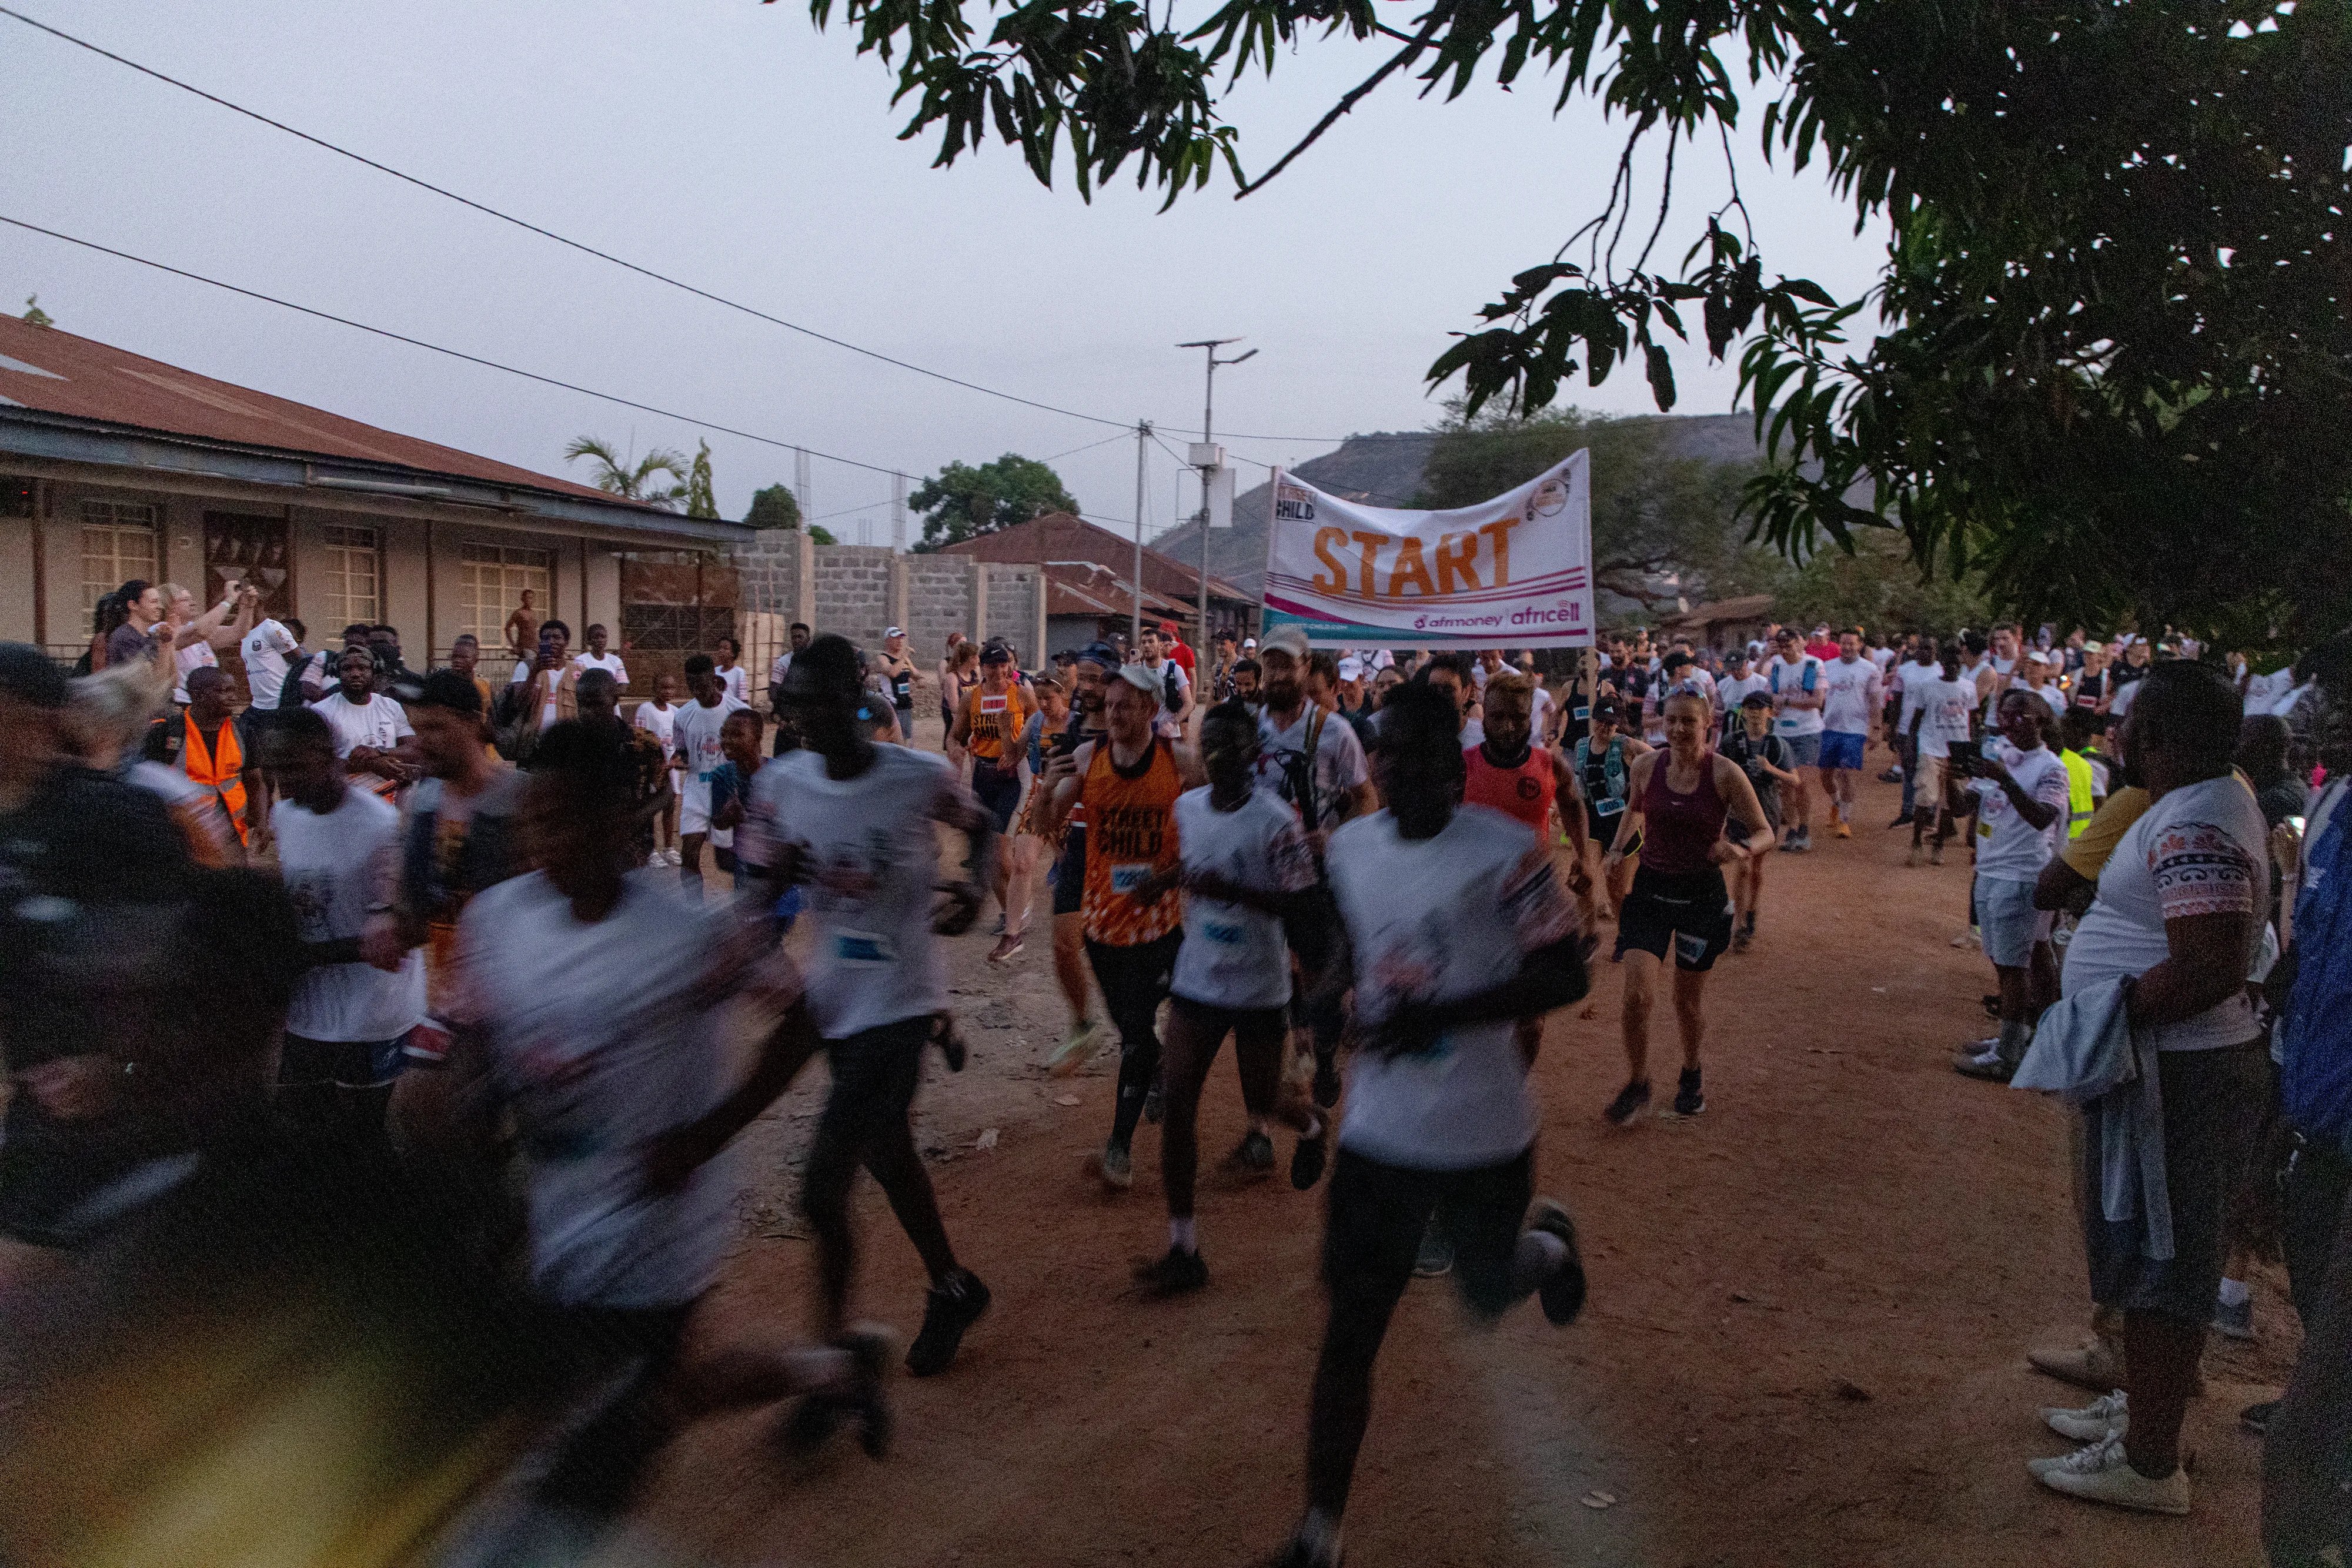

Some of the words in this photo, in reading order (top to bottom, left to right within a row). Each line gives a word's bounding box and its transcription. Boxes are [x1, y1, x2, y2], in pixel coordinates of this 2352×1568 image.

[1312, 517, 1521, 601] START
[1511, 601, 1580, 624] africell
[973, 713, 999, 725] STRE
